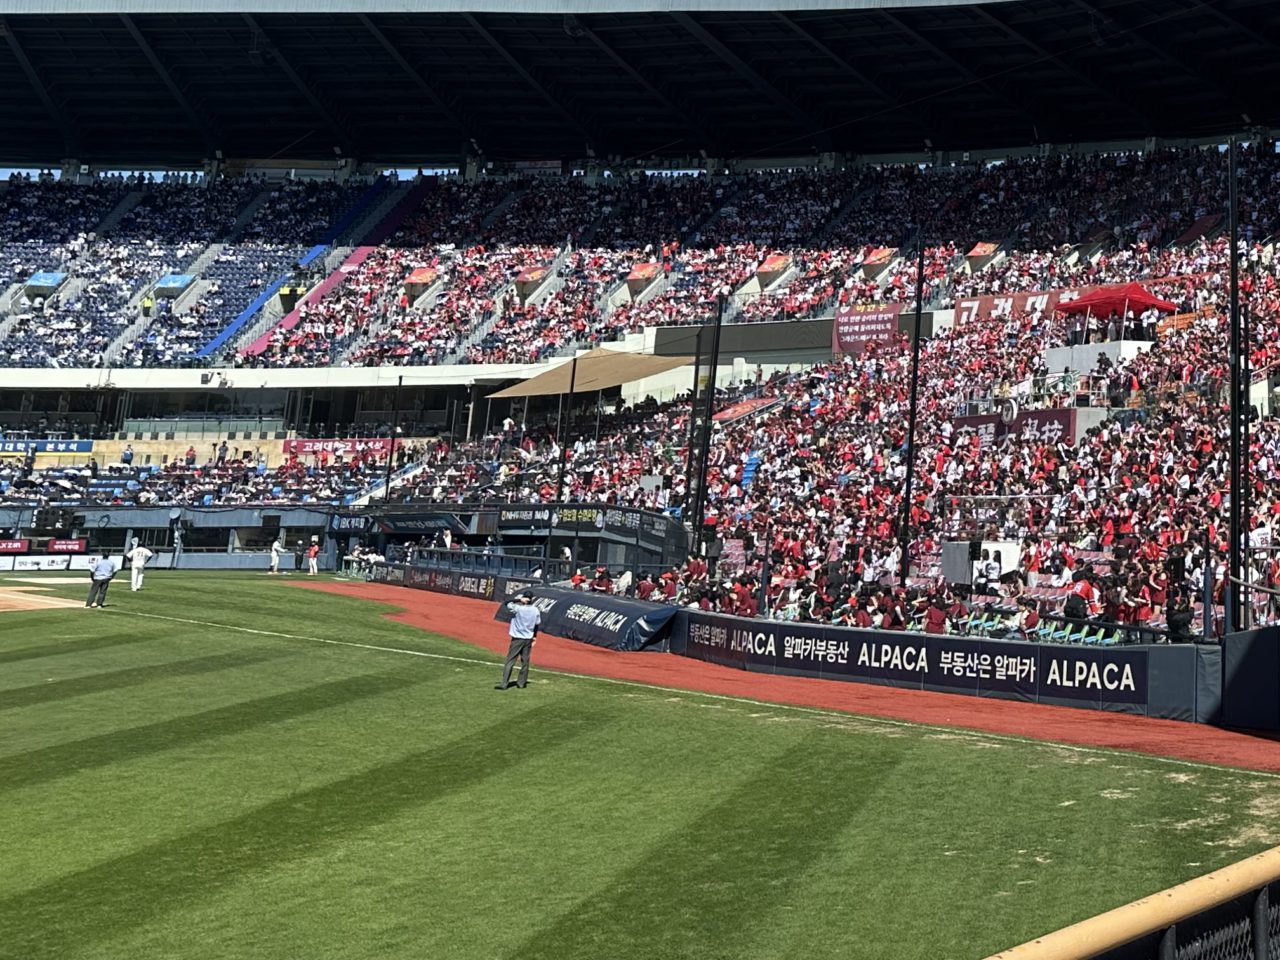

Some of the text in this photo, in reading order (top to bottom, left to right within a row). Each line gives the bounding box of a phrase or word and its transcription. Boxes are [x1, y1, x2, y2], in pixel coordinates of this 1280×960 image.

[302, 441, 352, 452] 고려대교
[689, 622, 1136, 692] 부동산은 알파카 ALPACA 알파카부동산 ALPACA 부동산은 알파카 ALPACA
